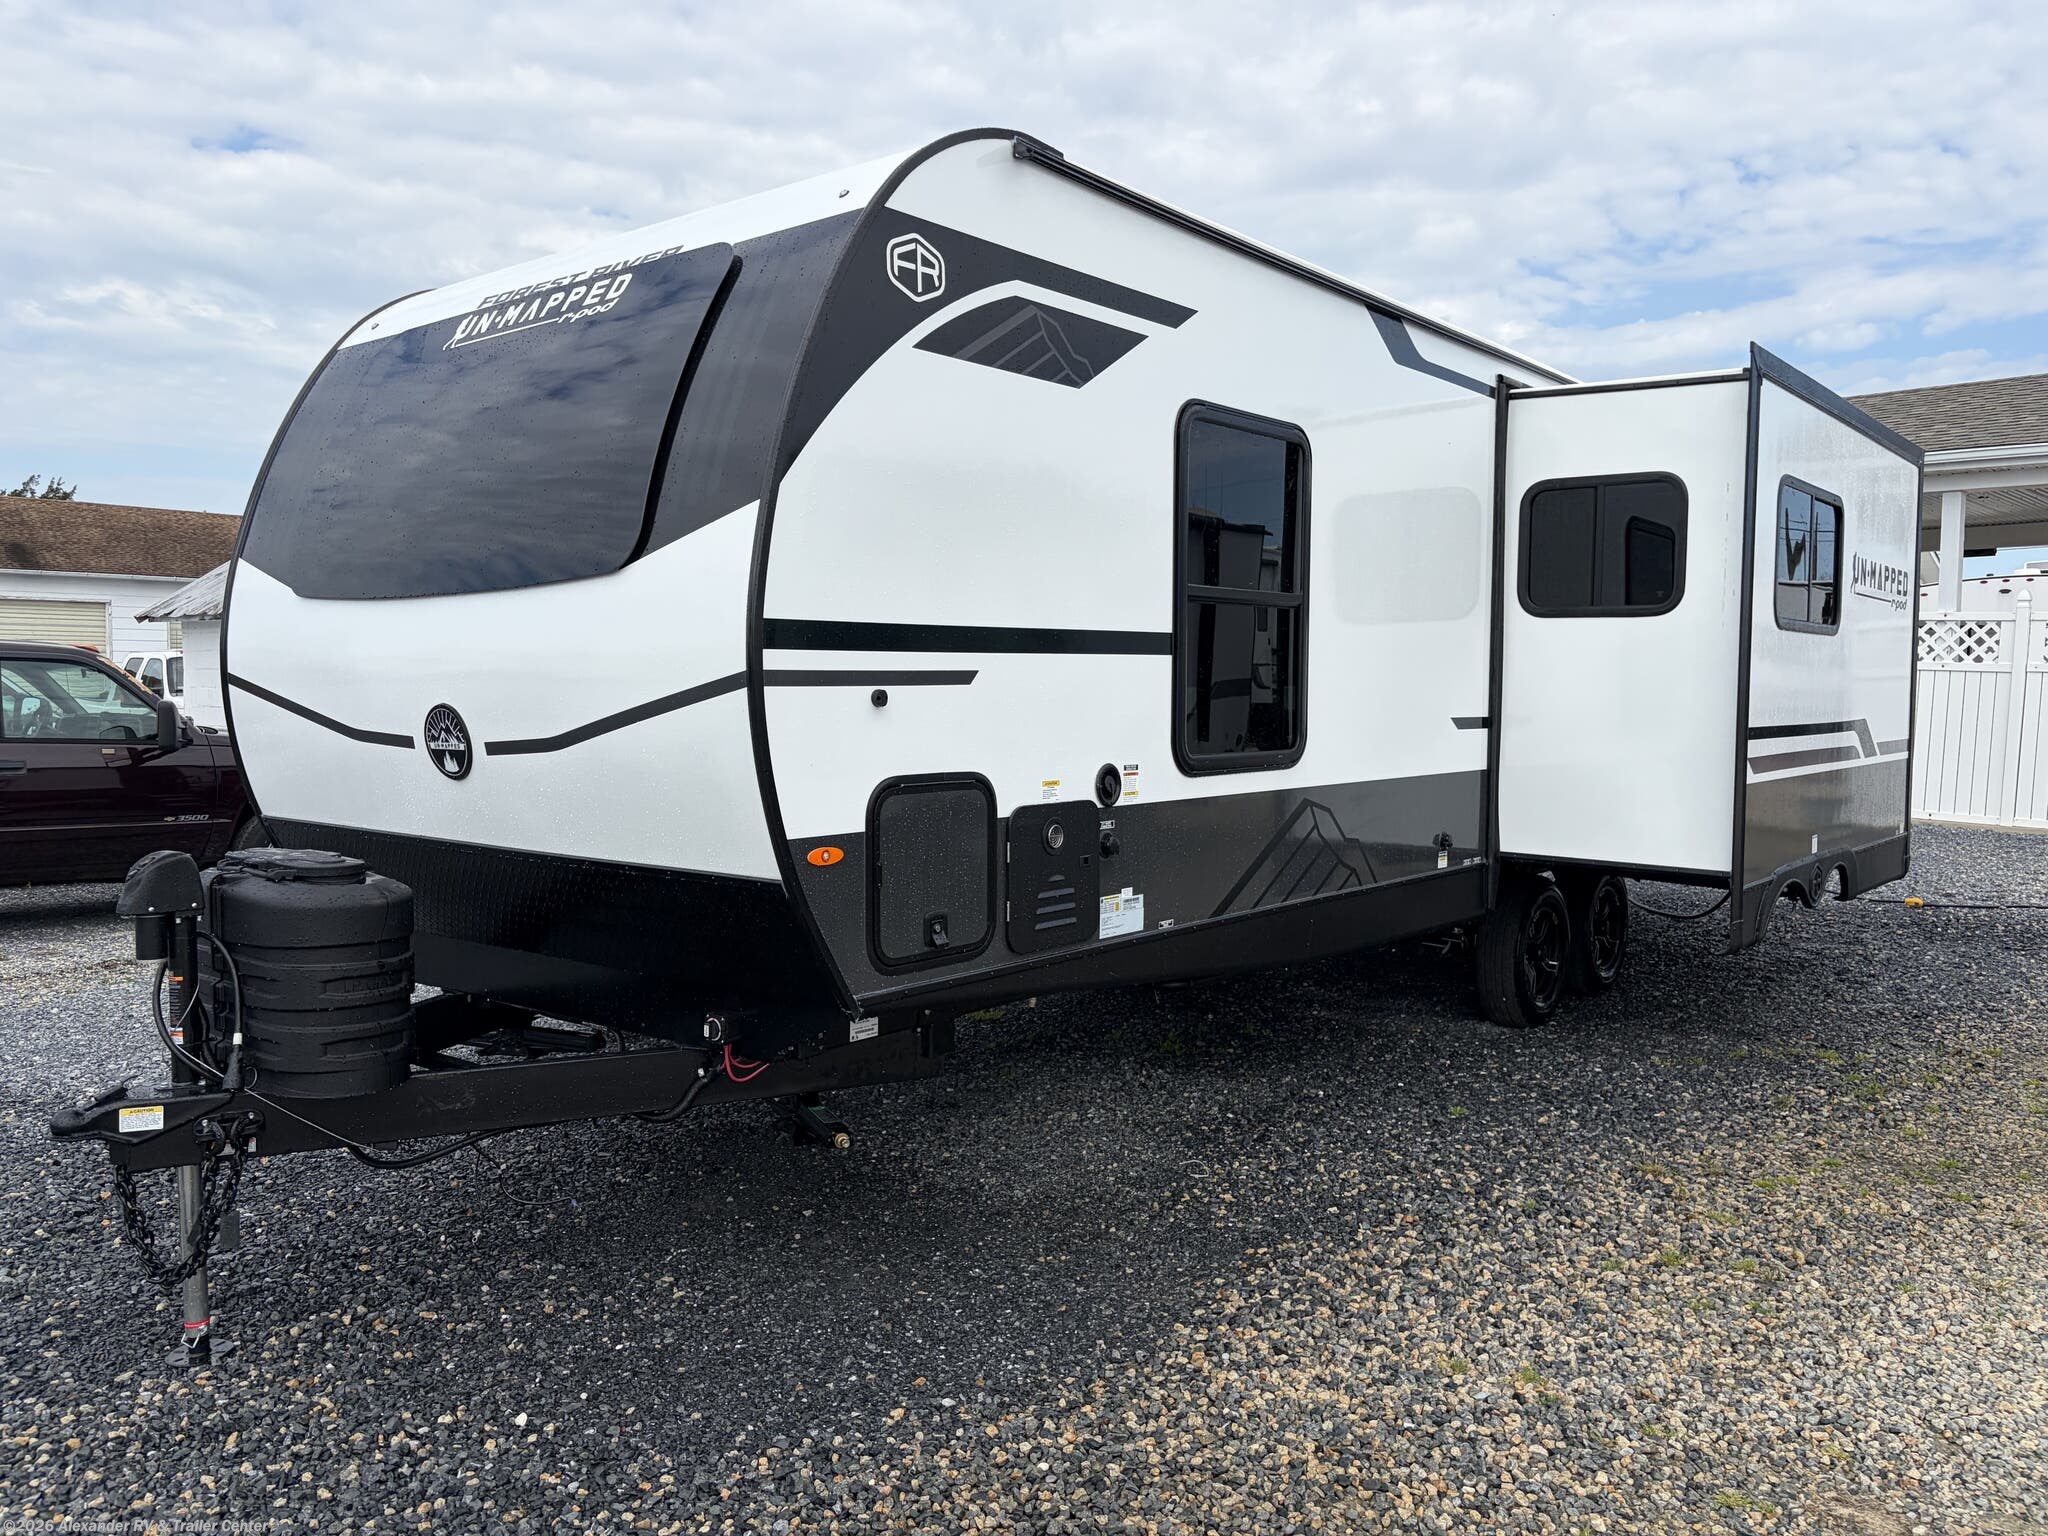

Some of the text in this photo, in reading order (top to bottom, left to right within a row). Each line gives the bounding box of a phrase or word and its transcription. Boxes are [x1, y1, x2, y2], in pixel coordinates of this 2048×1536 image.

[477, 245, 684, 309] FOREST RIVER
[176, 814, 210, 822] 3500
